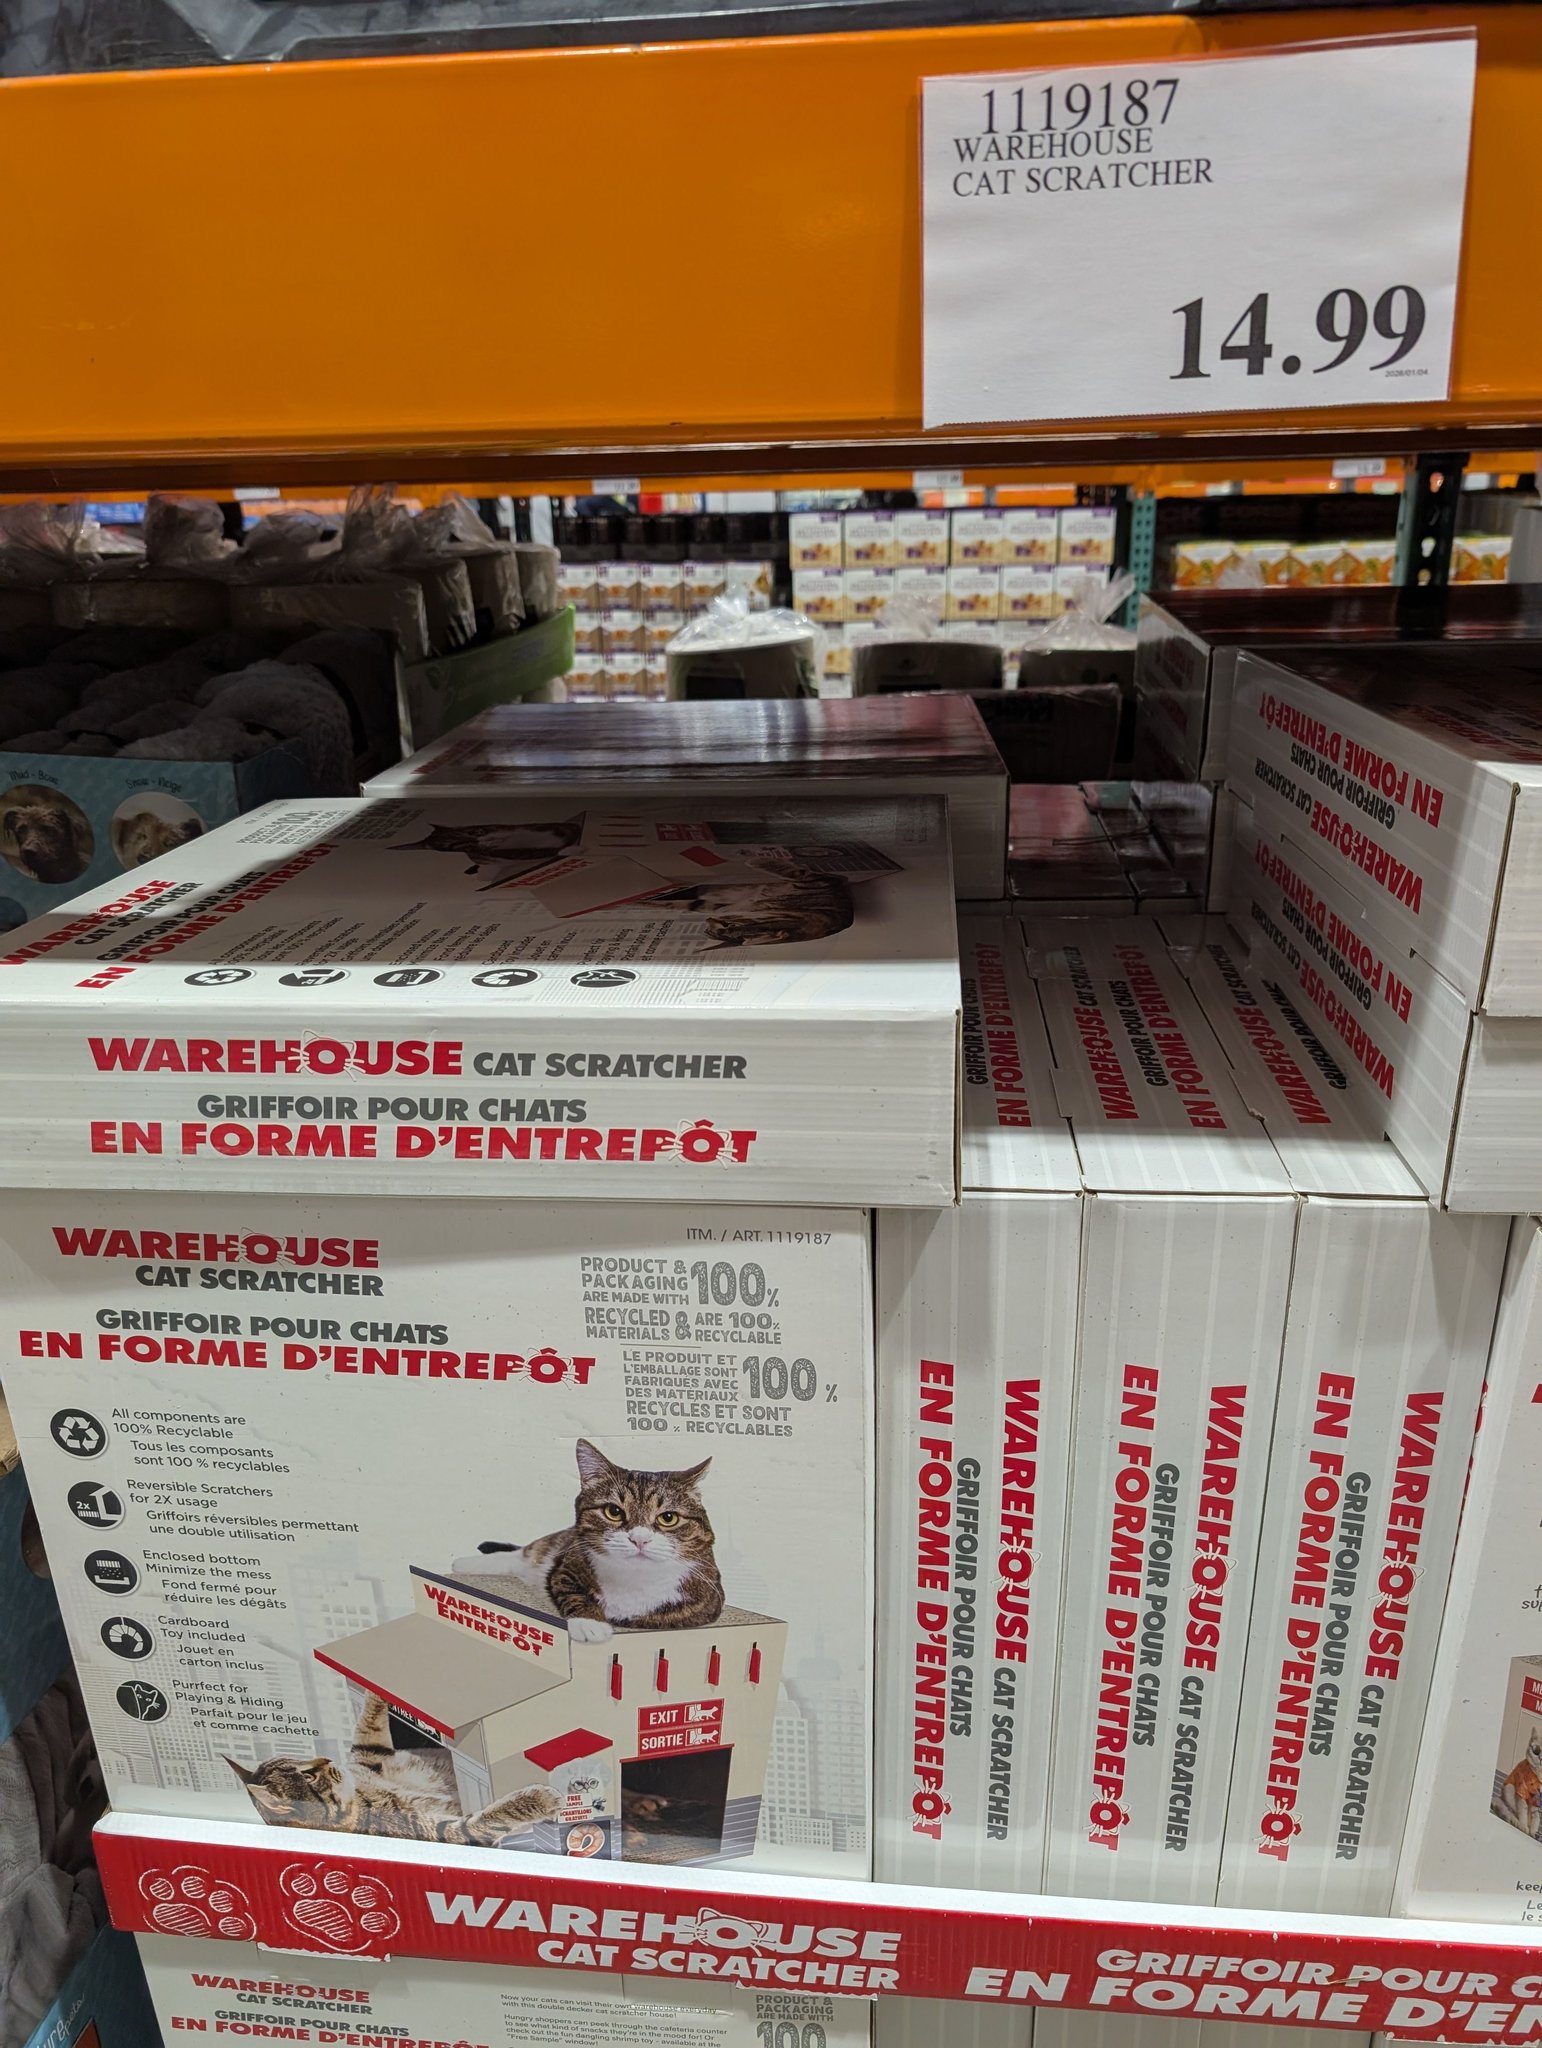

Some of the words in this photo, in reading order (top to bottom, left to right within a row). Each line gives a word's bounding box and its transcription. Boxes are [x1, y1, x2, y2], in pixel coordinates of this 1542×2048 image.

[982, 79, 1179, 134] 1119187
[953, 127, 1153, 163] WAREHOUSE
[953, 169, 1016, 197] CAT
[1025, 158, 1213, 193] SCRATCHER
[1170, 285, 1426, 379] 14.99
[1254, 756, 1297, 799] SCRATCHER
[1342, 738, 1409, 807] FORME
[1294, 788, 1311, 815] CAT
[1411, 777, 1444, 828] EN
[1310, 799, 1424, 916] WAREHOUSE
[0, 879, 179, 966] WAREHOUSE
[75, 966, 138, 989] EN
[120, 915, 228, 963] FORME
[88, 1037, 463, 1076] WAREHOUSE
[473, 1053, 537, 1076] CAT
[544, 1053, 748, 1079] SCRATCHER
[985, 1030, 1026, 1093] FORME
[197, 1094, 359, 1121] GRIFFOIR
[367, 1097, 469, 1122] POUR
[478, 1098, 588, 1123] CHATS
[995, 1099, 1032, 1128] EN
[90, 1121, 163, 1155] EN
[181, 1122, 377, 1159] FORME
[395, 1118, 757, 1165] D'ENTREPÔT
[52, 1226, 379, 1269] WAREHOUSE
[686, 1228, 716, 1241] ITM.
[732, 1230, 763, 1243] ART.
[768, 1231, 832, 1245] 1119187
[580, 1256, 668, 1274] PRODUCT
[673, 1259, 687, 1274] &
[135, 1264, 191, 1287] CAT
[200, 1267, 385, 1296] SCRATCHER
[581, 1273, 688, 1291] PACKAGING
[583, 1290, 609, 1302] ARE
[611, 1292, 650, 1304] MADE
[653, 1292, 690, 1305] WITH
[96, 1308, 242, 1335] GRIFFOIR
[250, 1316, 342, 1340] POUR
[350, 1321, 449, 1346] CHATS
[584, 1307, 670, 1327] RECYCLED
[694, 1312, 723, 1326] ARE
[586, 1325, 670, 1341] MATERIALS
[695, 1329, 782, 1345] RECYCLABLE
[19, 1330, 83, 1359] EN
[99, 1333, 268, 1369] FORME
[283, 1341, 596, 1386] D'ENTREPÔT
[623, 1350, 642, 1362] LE
[645, 1351, 713, 1365] PRODUIT
[717, 1353, 737, 1365] ET
[624, 1363, 701, 1376] L'EMBALLAGE
[704, 1367, 738, 1378] SONT
[743, 1355, 817, 1401] 100
[625, 1387, 652, 1398] DES
[703, 1378, 739, 1390] AVEC
[919, 1359, 954, 1426] EN
[111, 1408, 129, 1419] All
[133, 1409, 221, 1425] components
[224, 1414, 246, 1425] are
[715, 1404, 738, 1419] ET
[742, 1406, 792, 1421] SONT
[113, 1422, 152, 1435] 100%
[157, 1424, 234, 1440] Recyclable
[626, 1417, 668, 1431] 100
[686, 1421, 793, 1437] RECYCLABLES
[130, 1440, 162, 1452] Tous
[165, 1441, 186, 1453] les
[188, 1444, 274, 1459] composants
[134, 1455, 164, 1467] sont
[166, 1456, 193, 1468] 100
[212, 1459, 290, 1474] recyclables
[126, 1479, 198, 1493] Reversible
[201, 1483, 273, 1498] Scratchers
[129, 1493, 149, 1504] for
[153, 1494, 173, 1505] 2X
[176, 1497, 218, 1509] usage
[146, 1509, 201, 1523] Griffoirs
[204, 1511, 278, 1528] réversibles
[281, 1518, 359, 1533] permettant
[917, 1436, 952, 1593] FORME
[954, 1457, 981, 1582] GRIFFOIR
[994, 1378, 1041, 1664] WAREHOUSE
[149, 1524, 174, 1535] une
[177, 1523, 226, 1538] double
[229, 1528, 296, 1543] utilisation
[143, 1549, 205, 1563] Enclosed
[209, 1552, 261, 1566] bottom
[145, 1563, 206, 1576] Minimize
[209, 1566, 232, 1578] the
[236, 1570, 272, 1580] mess
[161, 1579, 196, 1591] Fond
[200, 1580, 241, 1593] fermé
[245, 1585, 277, 1597] pour
[164, 1593, 213, 1605] réduire
[217, 1595, 236, 1606] les
[239, 1596, 287, 1610] dégâts
[157, 1615, 230, 1629] Cardboard
[424, 1583, 554, 1646] WAREHOUSE
[951, 1586, 976, 1659] POUR
[160, 1627, 184, 1640] Toy
[188, 1630, 246, 1643] included
[176, 1644, 214, 1657] Jouet
[217, 1648, 235, 1657] en
[179, 1657, 222, 1669] carton
[225, 1660, 264, 1671] inclus
[172, 1679, 226, 1693] Purrfect
[229, 1682, 248, 1693] for
[993, 1666, 1017, 1710] CAT
[175, 1691, 224, 1705] Playing
[227, 1695, 237, 1705] &
[240, 1696, 284, 1709] Hiding
[949, 1665, 974, 1738] CHATS
[190, 1706, 234, 1719] Parfait
[237, 1710, 269, 1722] pour
[271, 1712, 284, 1723] le
[286, 1713, 307, 1725] jeu
[649, 1709, 679, 1725] EXIT
[912, 1600, 952, 1840] D'ENTREPÔT
[193, 1718, 208, 1729] et
[210, 1721, 259, 1732] comme
[262, 1724, 319, 1737] cachette
[641, 1732, 684, 1751] SORTIE
[986, 1713, 1014, 1841] SCRATCHER
[425, 1891, 902, 1961] WAREHOUSE
[537, 1940, 620, 1968] CAT
[631, 1947, 900, 1990] SCRATCHER
[1096, 1948, 1335, 1985] GRIFFOIR
[1345, 1964, 1499, 1996] POUR
[964, 1966, 1071, 2002] EN
[1090, 1976, 1369, 2024] FORME
[504, 2014, 533, 2022] Hungry
[535, 2016, 572, 2024] shoppers
[660, 2025, 695, 2033] cafeteria
